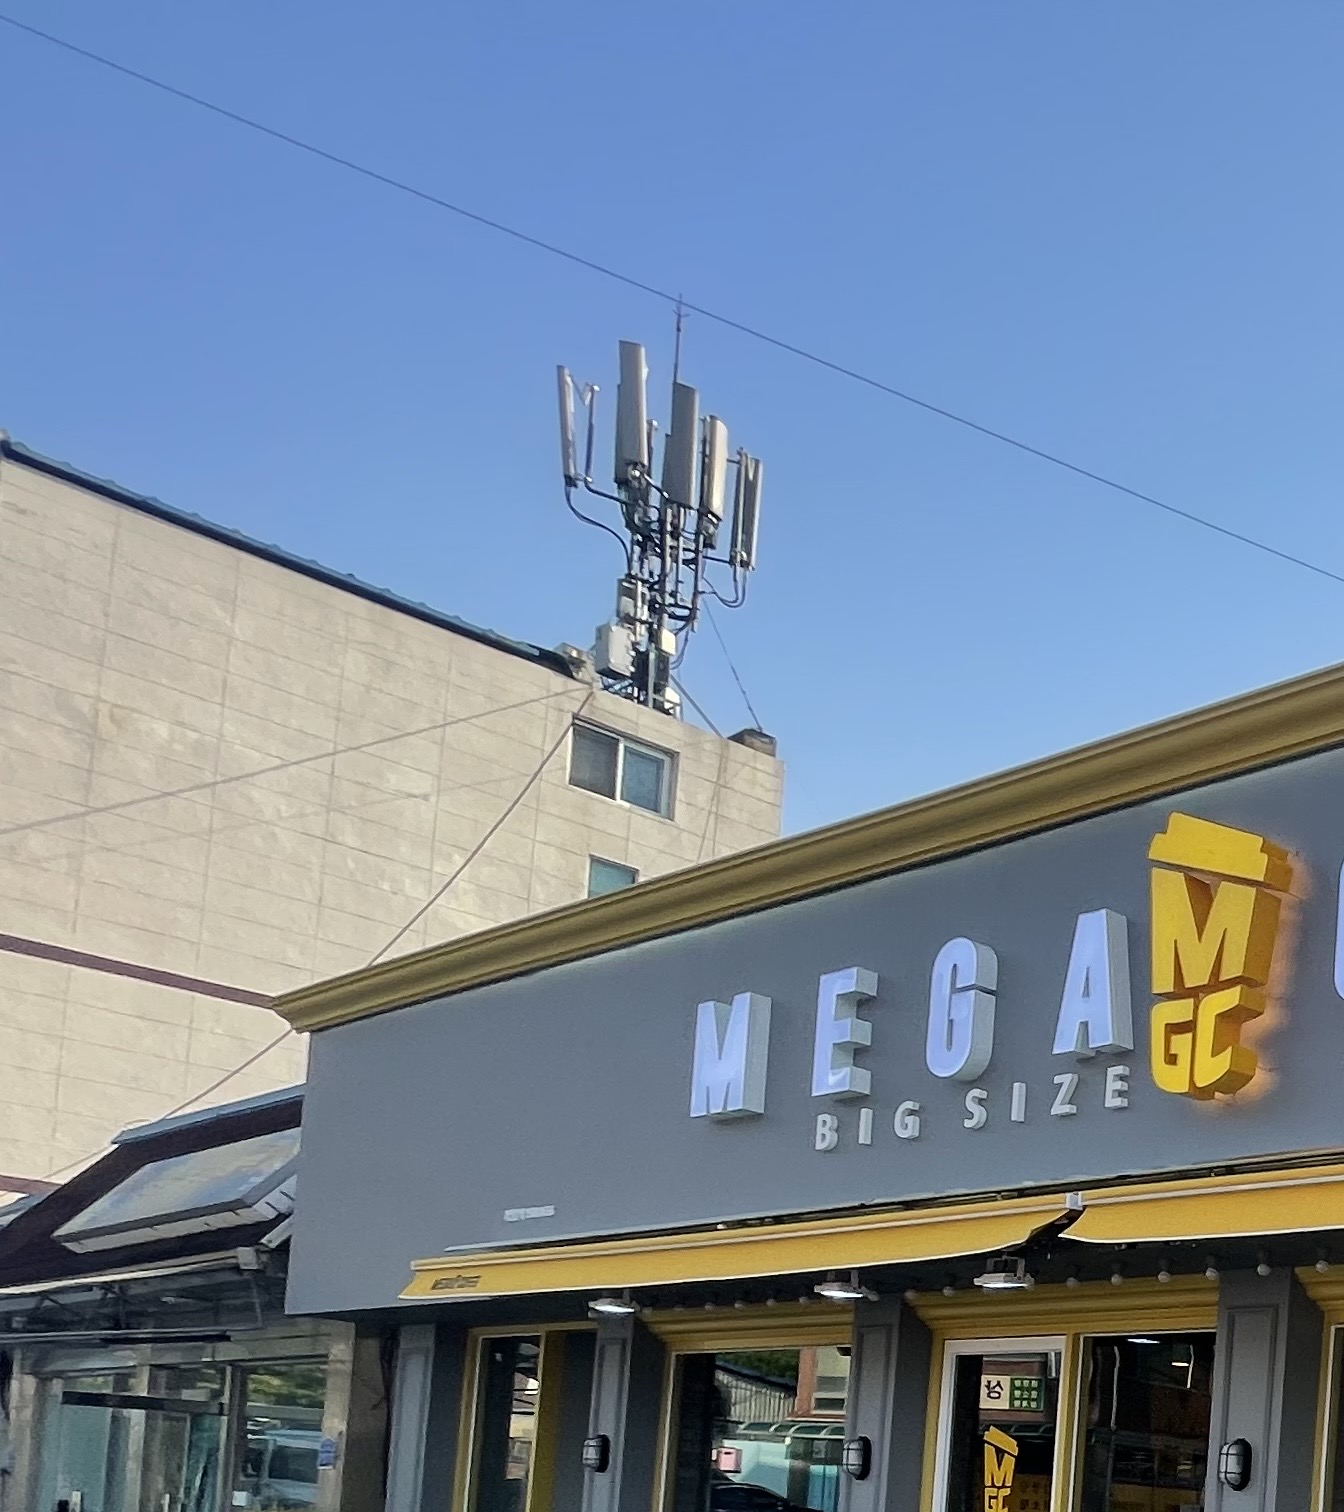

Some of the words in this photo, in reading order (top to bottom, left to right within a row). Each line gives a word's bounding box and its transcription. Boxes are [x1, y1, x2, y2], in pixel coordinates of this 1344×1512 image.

[690, 908, 1134, 1120] MEGA
[814, 1100, 921, 1152] BIG
[964, 1064, 1130, 1130] SIZE
